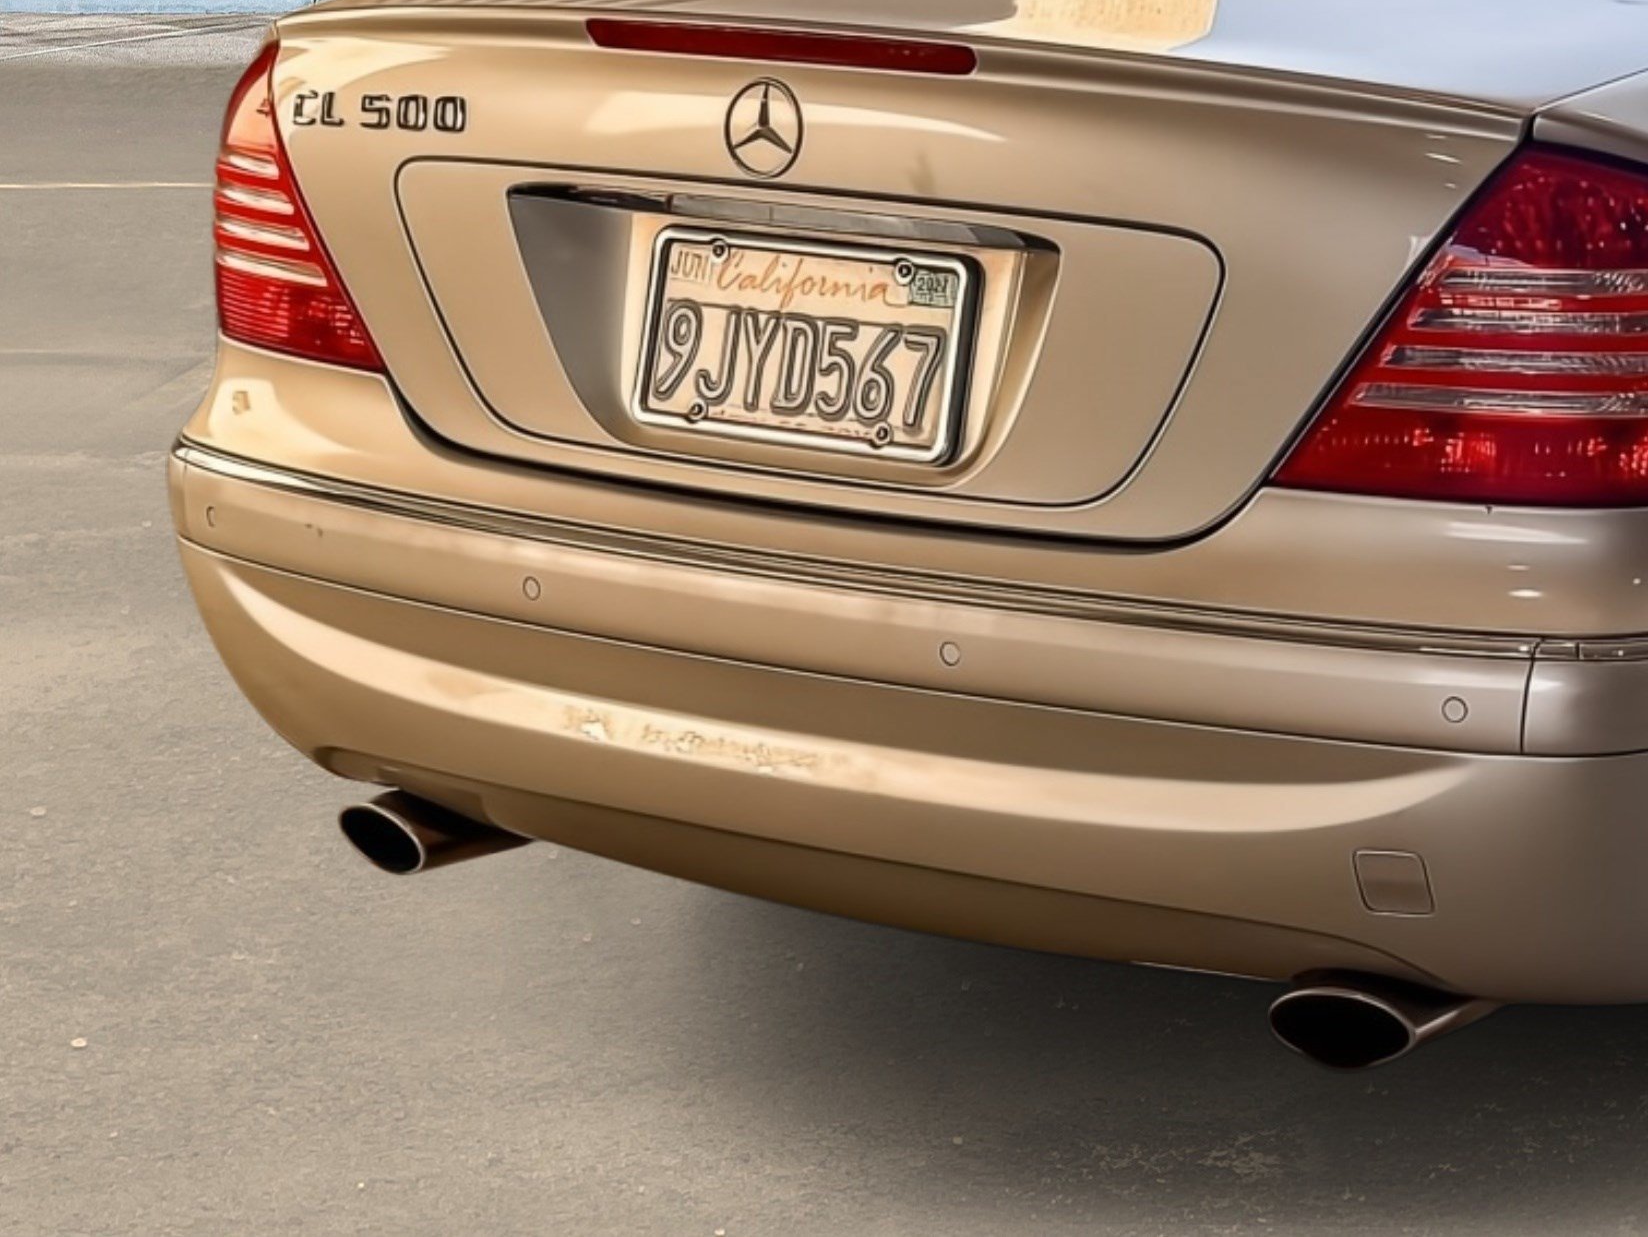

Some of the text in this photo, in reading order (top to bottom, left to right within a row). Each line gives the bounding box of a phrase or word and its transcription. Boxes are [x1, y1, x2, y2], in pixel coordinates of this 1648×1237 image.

[292, 90, 467, 133] CL 500
[716, 250, 910, 308] California
[652, 300, 949, 436] 9JYD567
